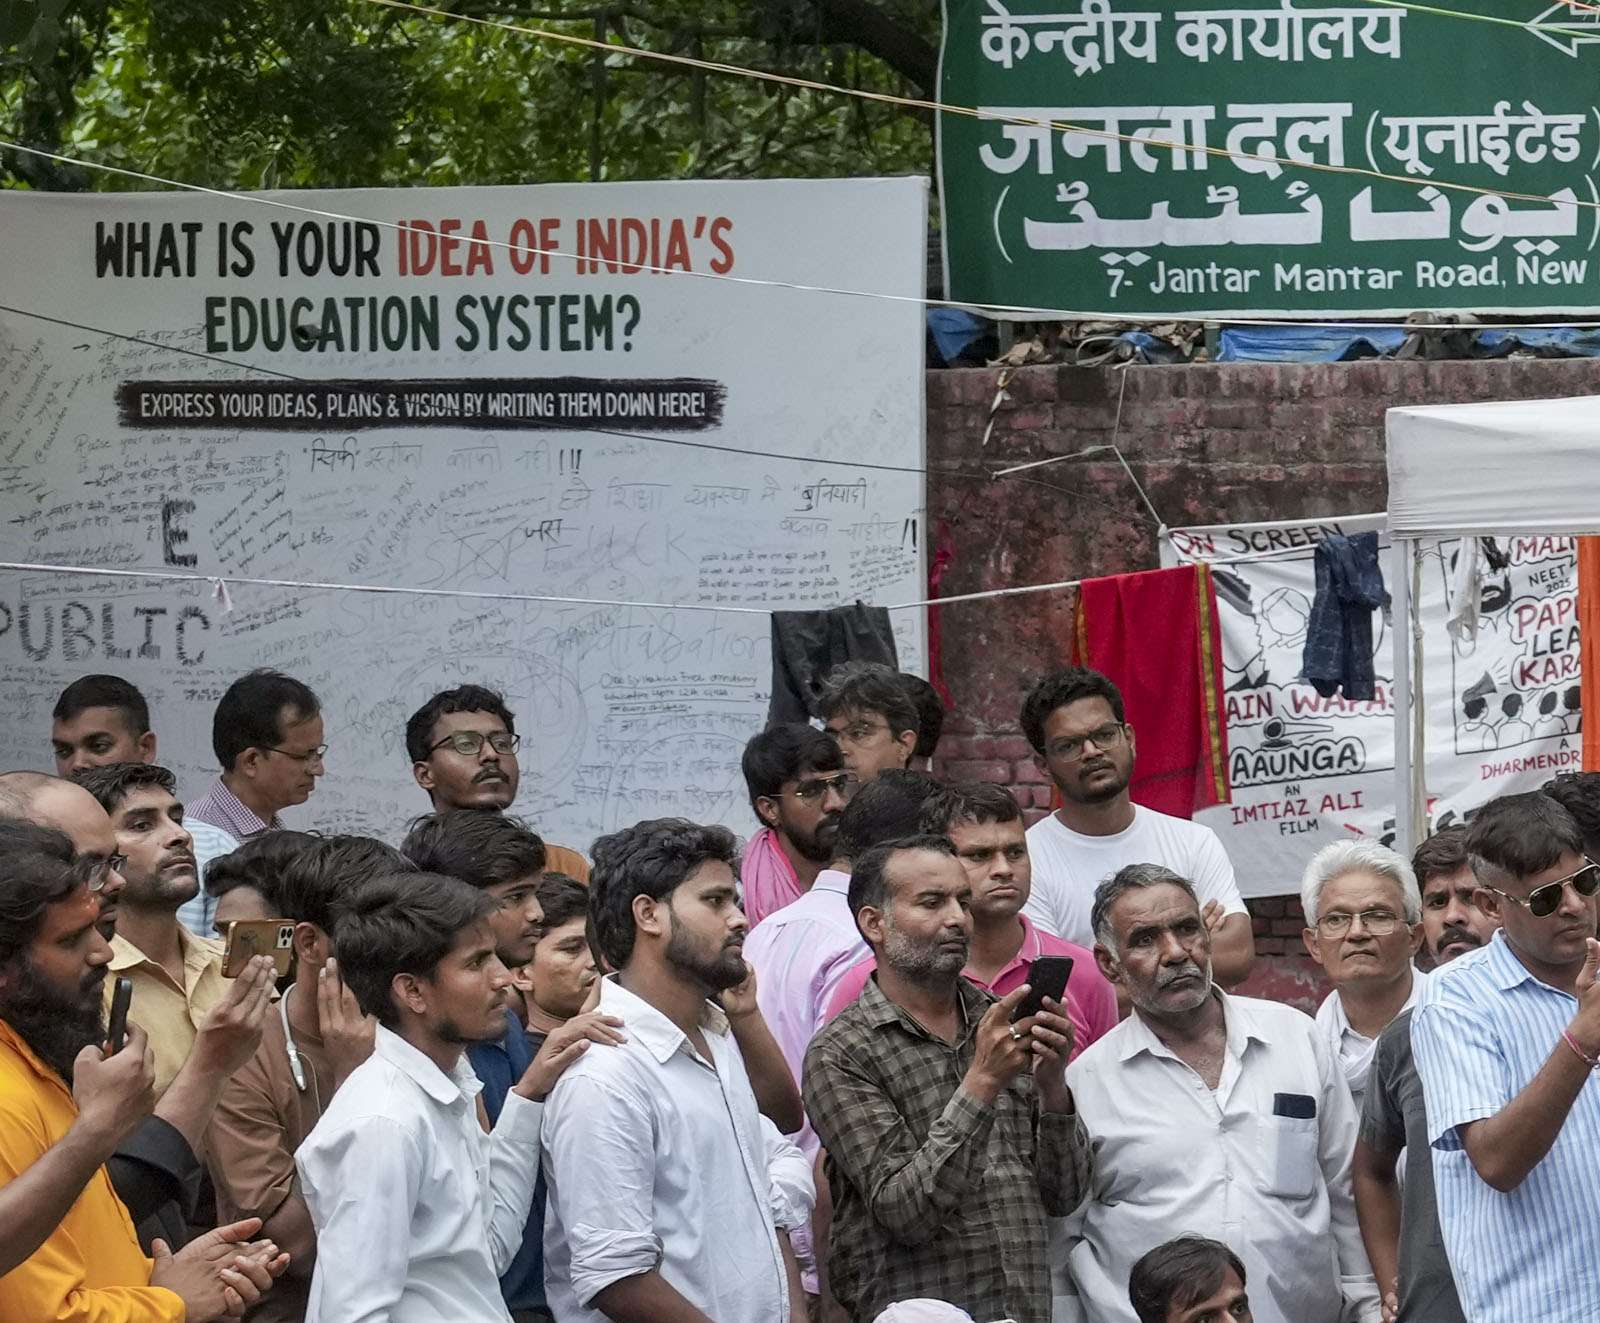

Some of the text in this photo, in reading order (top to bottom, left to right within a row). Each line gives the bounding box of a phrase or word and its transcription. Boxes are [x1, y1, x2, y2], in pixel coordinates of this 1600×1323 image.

[977, 104, 1216, 175] जनता
[1225, 102, 1354, 178] दल
[95, 216, 735, 278] WHAT IS YOUR IDEA OF INDIA'S
[1150, 260, 1261, 296] Jantar
[1273, 264, 1403, 293] Mantar
[1415, 255, 1507, 290] Road,
[1515, 257, 1589, 287] New
[205, 294, 641, 353] EDUCATION SYSTEM?
[141, 391, 706, 420] EXPRESS YOUR IDEAS, PLANS & VISION BY WRITING THEM DOWN HERE!
[1528, 564, 1566, 587] NEET
[1546, 577, 1571, 593] 2025
[1559, 738, 1570, 750] A
[1232, 743, 1359, 782] AAUNGA
[1284, 784, 1301, 797] AN
[1231, 791, 1364, 825] IMTIAZ ALI
[1279, 819, 1319, 835] FILM
